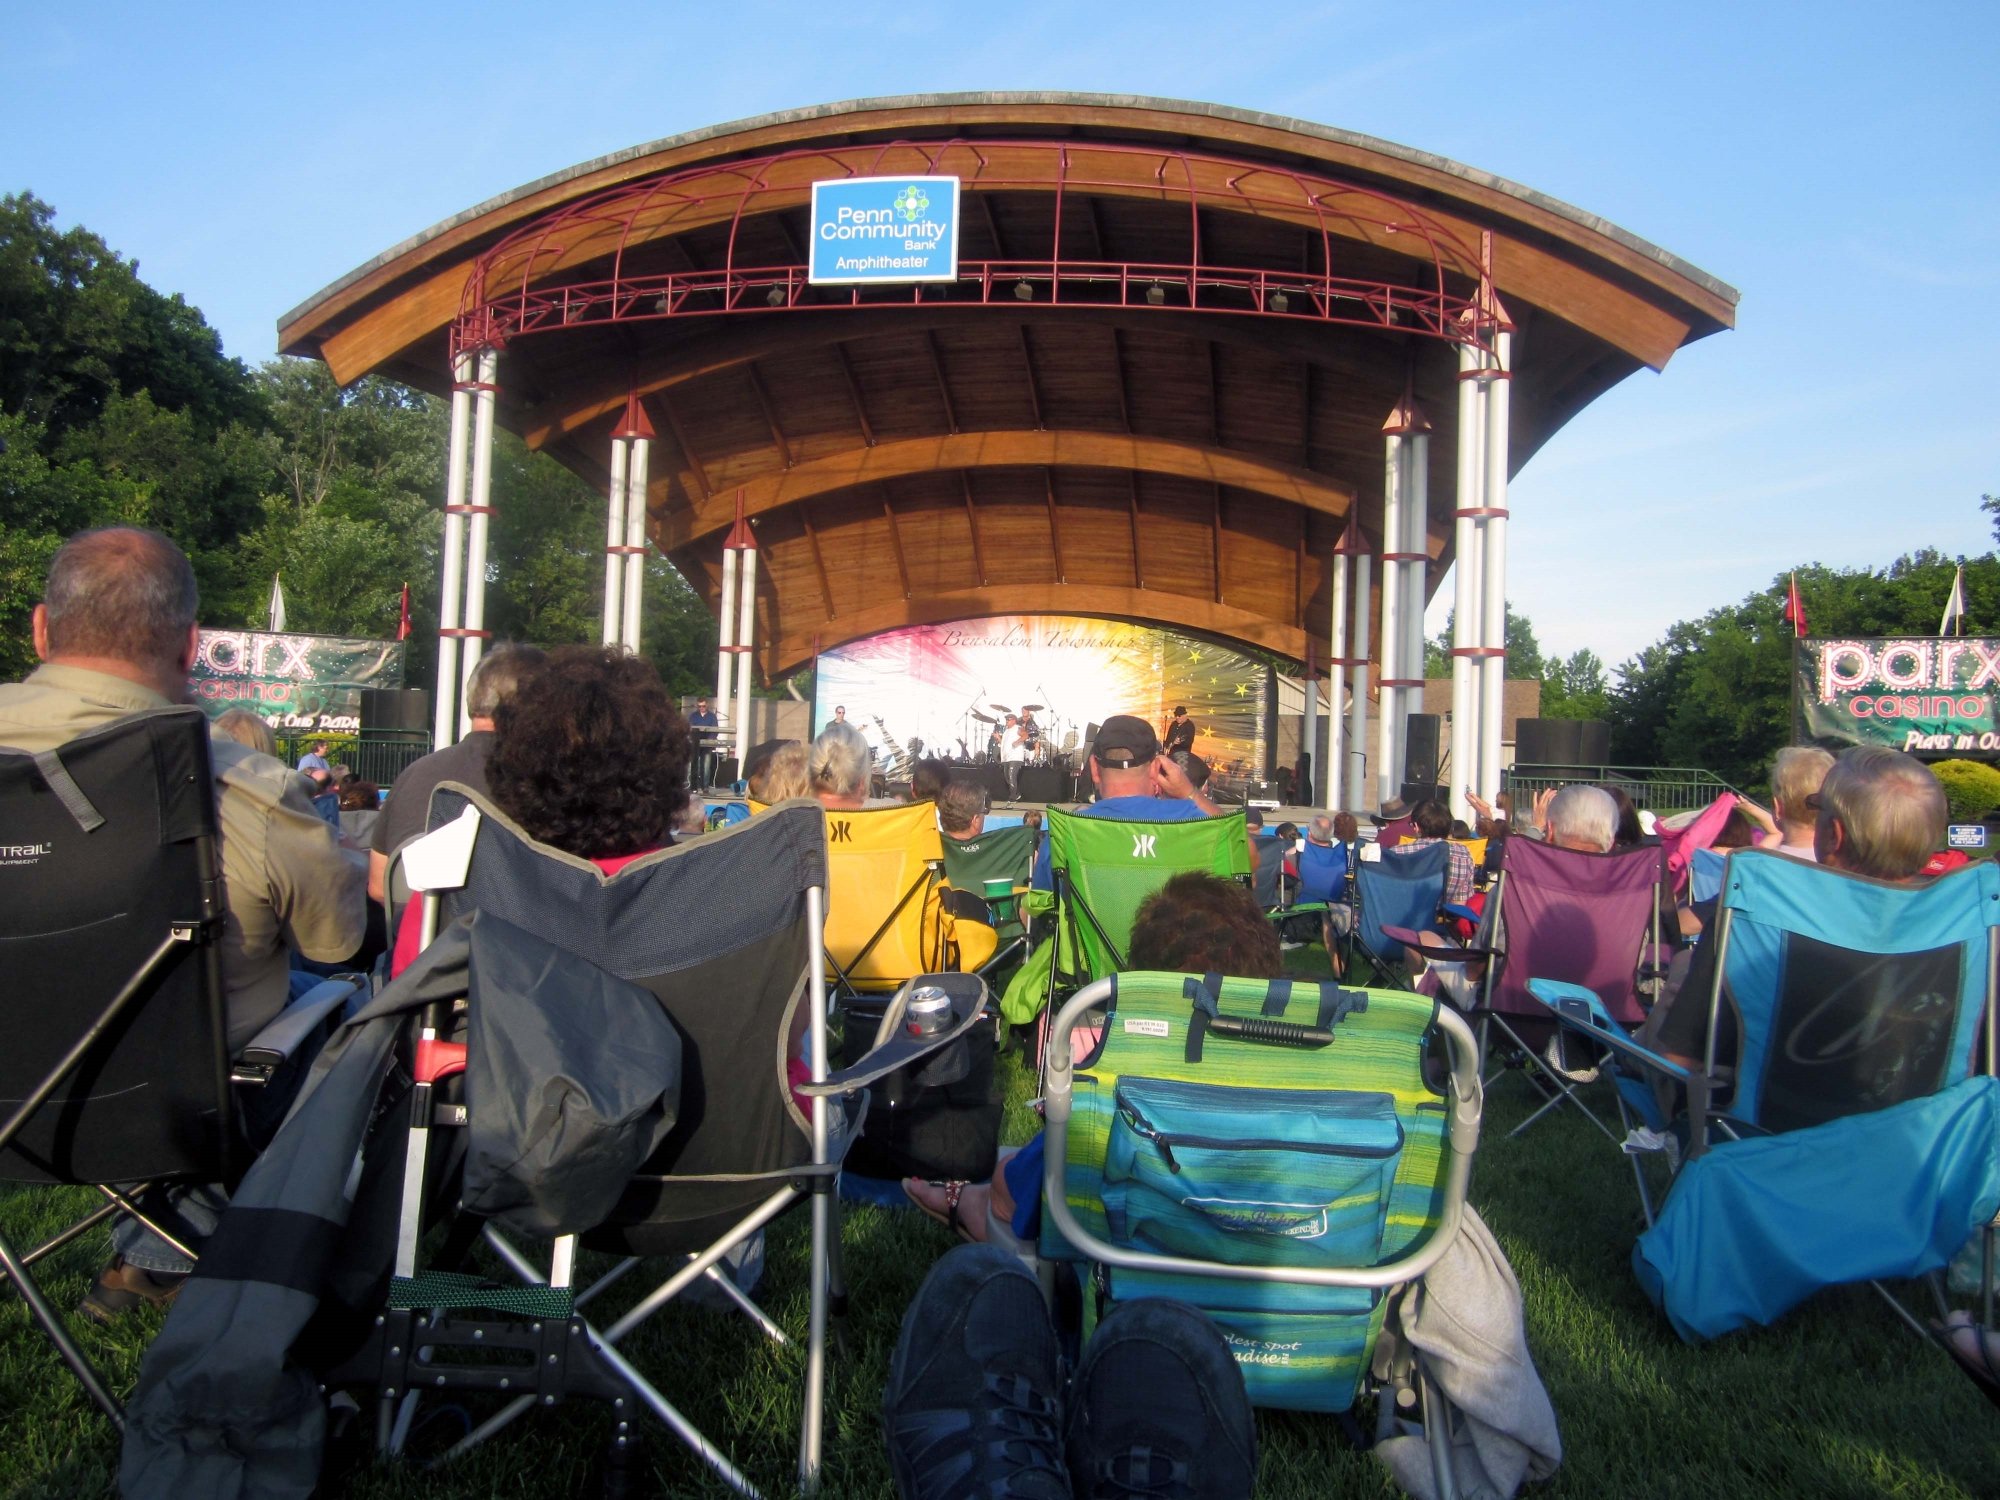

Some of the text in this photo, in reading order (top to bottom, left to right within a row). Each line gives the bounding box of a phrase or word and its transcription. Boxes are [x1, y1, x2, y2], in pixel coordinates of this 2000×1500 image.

[838, 207, 893, 224] Penn
[820, 220, 947, 241] Community
[904, 240, 936, 250] Bank
[835, 256, 929, 272] Amphitheater
[942, 624, 1032, 647] Bensalem
[203, 632, 315, 678] arx
[1819, 640, 2000, 704] parx
[1849, 695, 1985, 718] casino
[1233, 1348, 1281, 1365] adise
